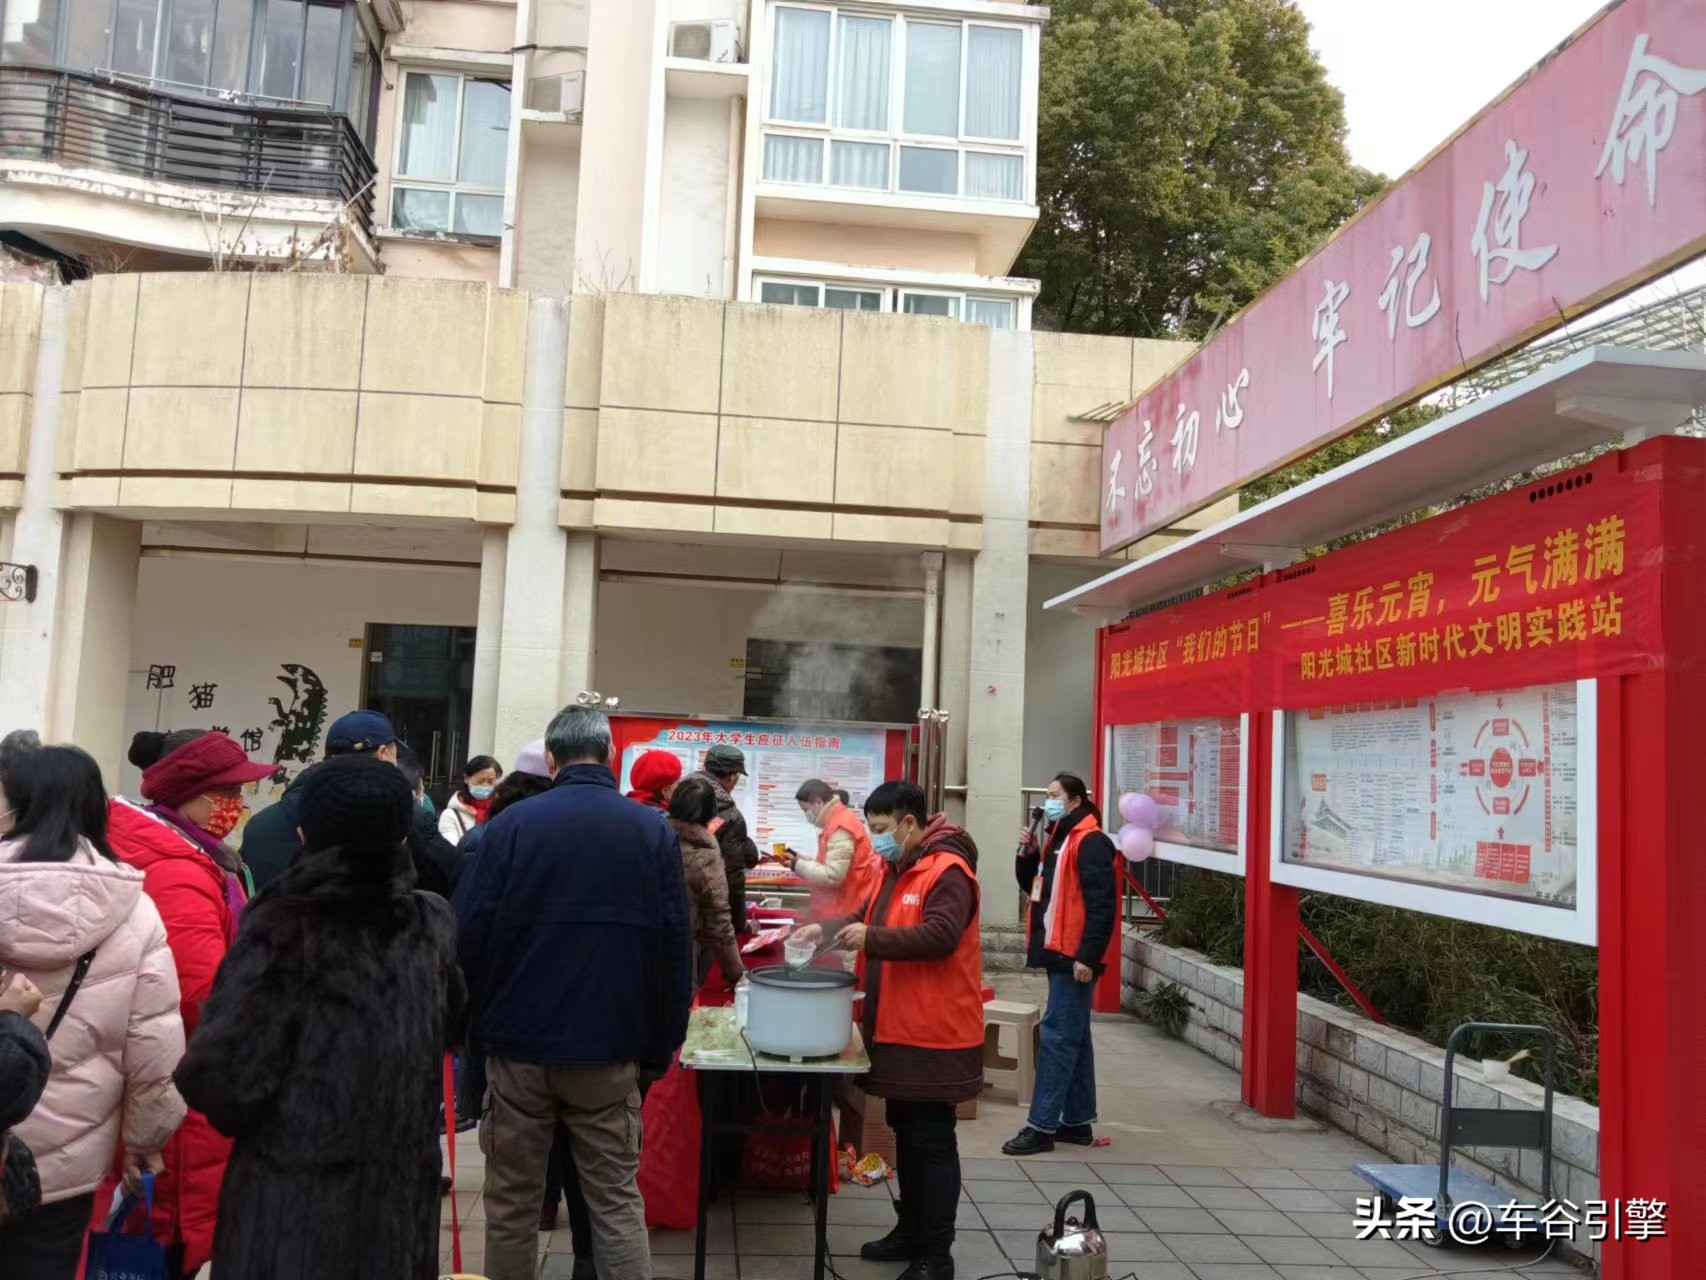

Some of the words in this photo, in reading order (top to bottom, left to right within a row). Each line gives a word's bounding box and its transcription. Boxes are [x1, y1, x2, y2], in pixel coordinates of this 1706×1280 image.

[1106, 368, 1249, 514] 不忘初心
[1312, 33, 1706, 400] 牢记使命
[1301, 591, 1625, 680] 阳光城社区新时代文明实践站
[668, 728, 842, 750] 2023年大学生应征入伍指南
